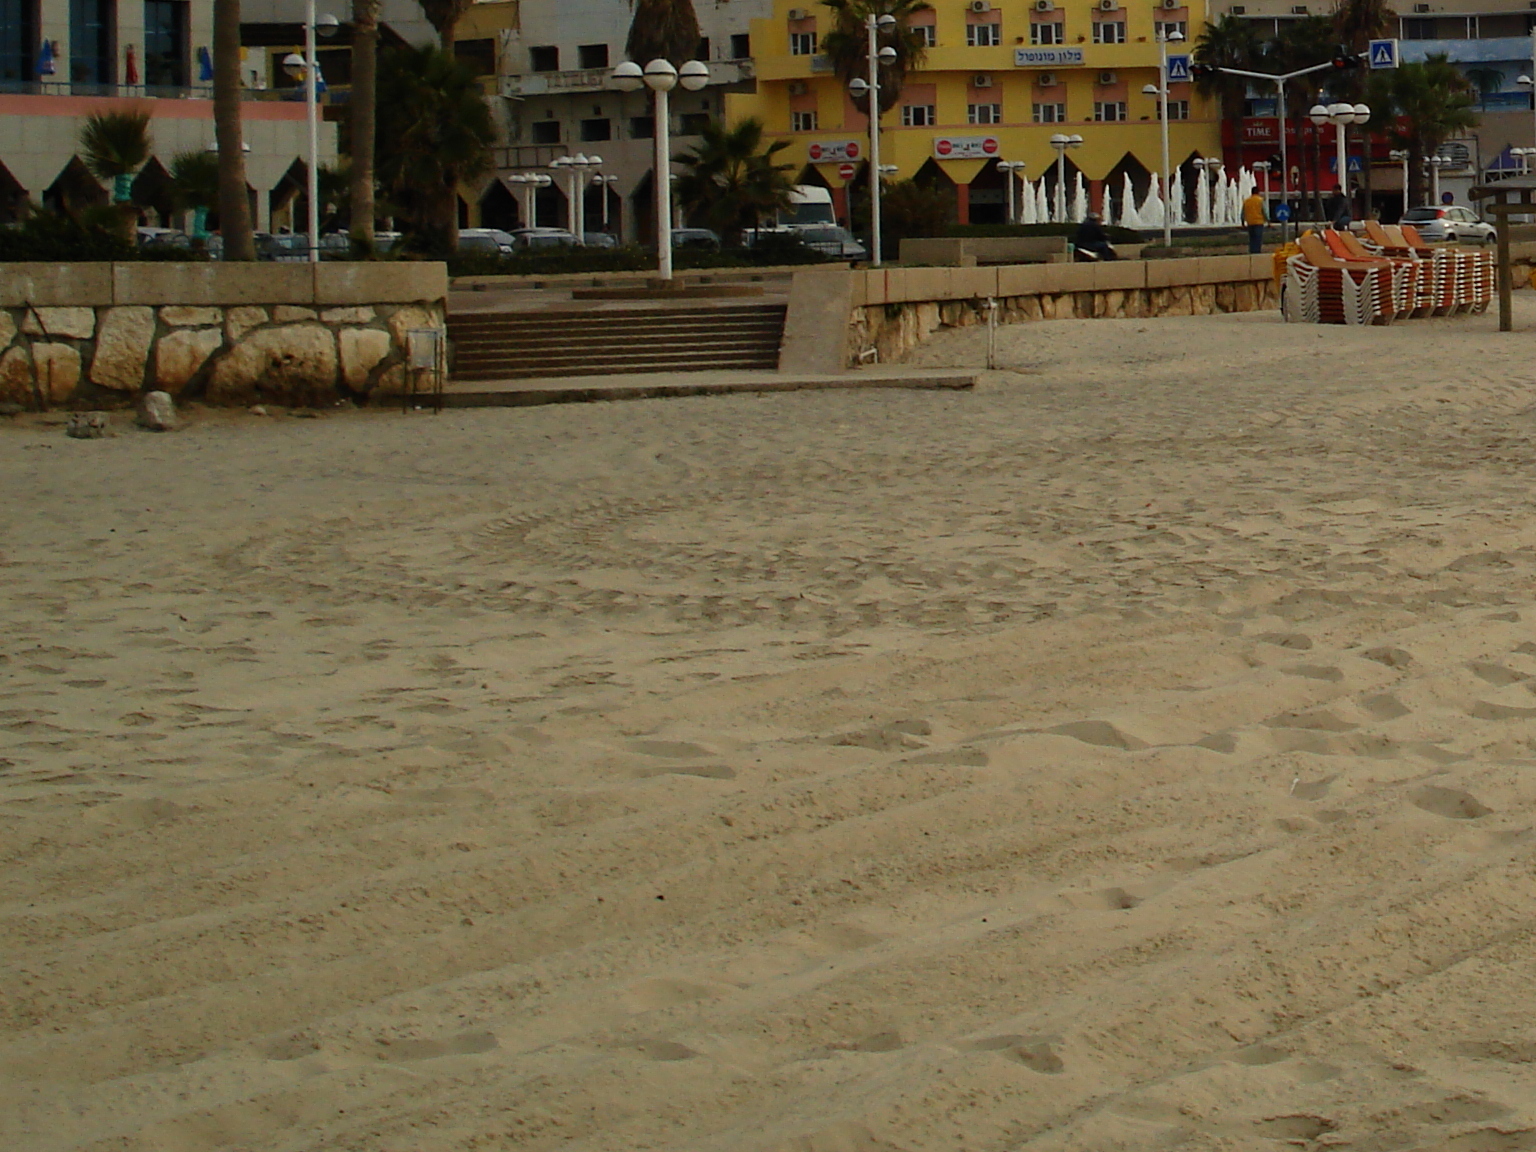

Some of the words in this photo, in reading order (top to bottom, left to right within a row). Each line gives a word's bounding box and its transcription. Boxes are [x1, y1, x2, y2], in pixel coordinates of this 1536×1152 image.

[1018, 51, 1055, 61] מונופול
[1059, 50, 1082, 64] מלון
[1246, 126, 1271, 137] TIME
